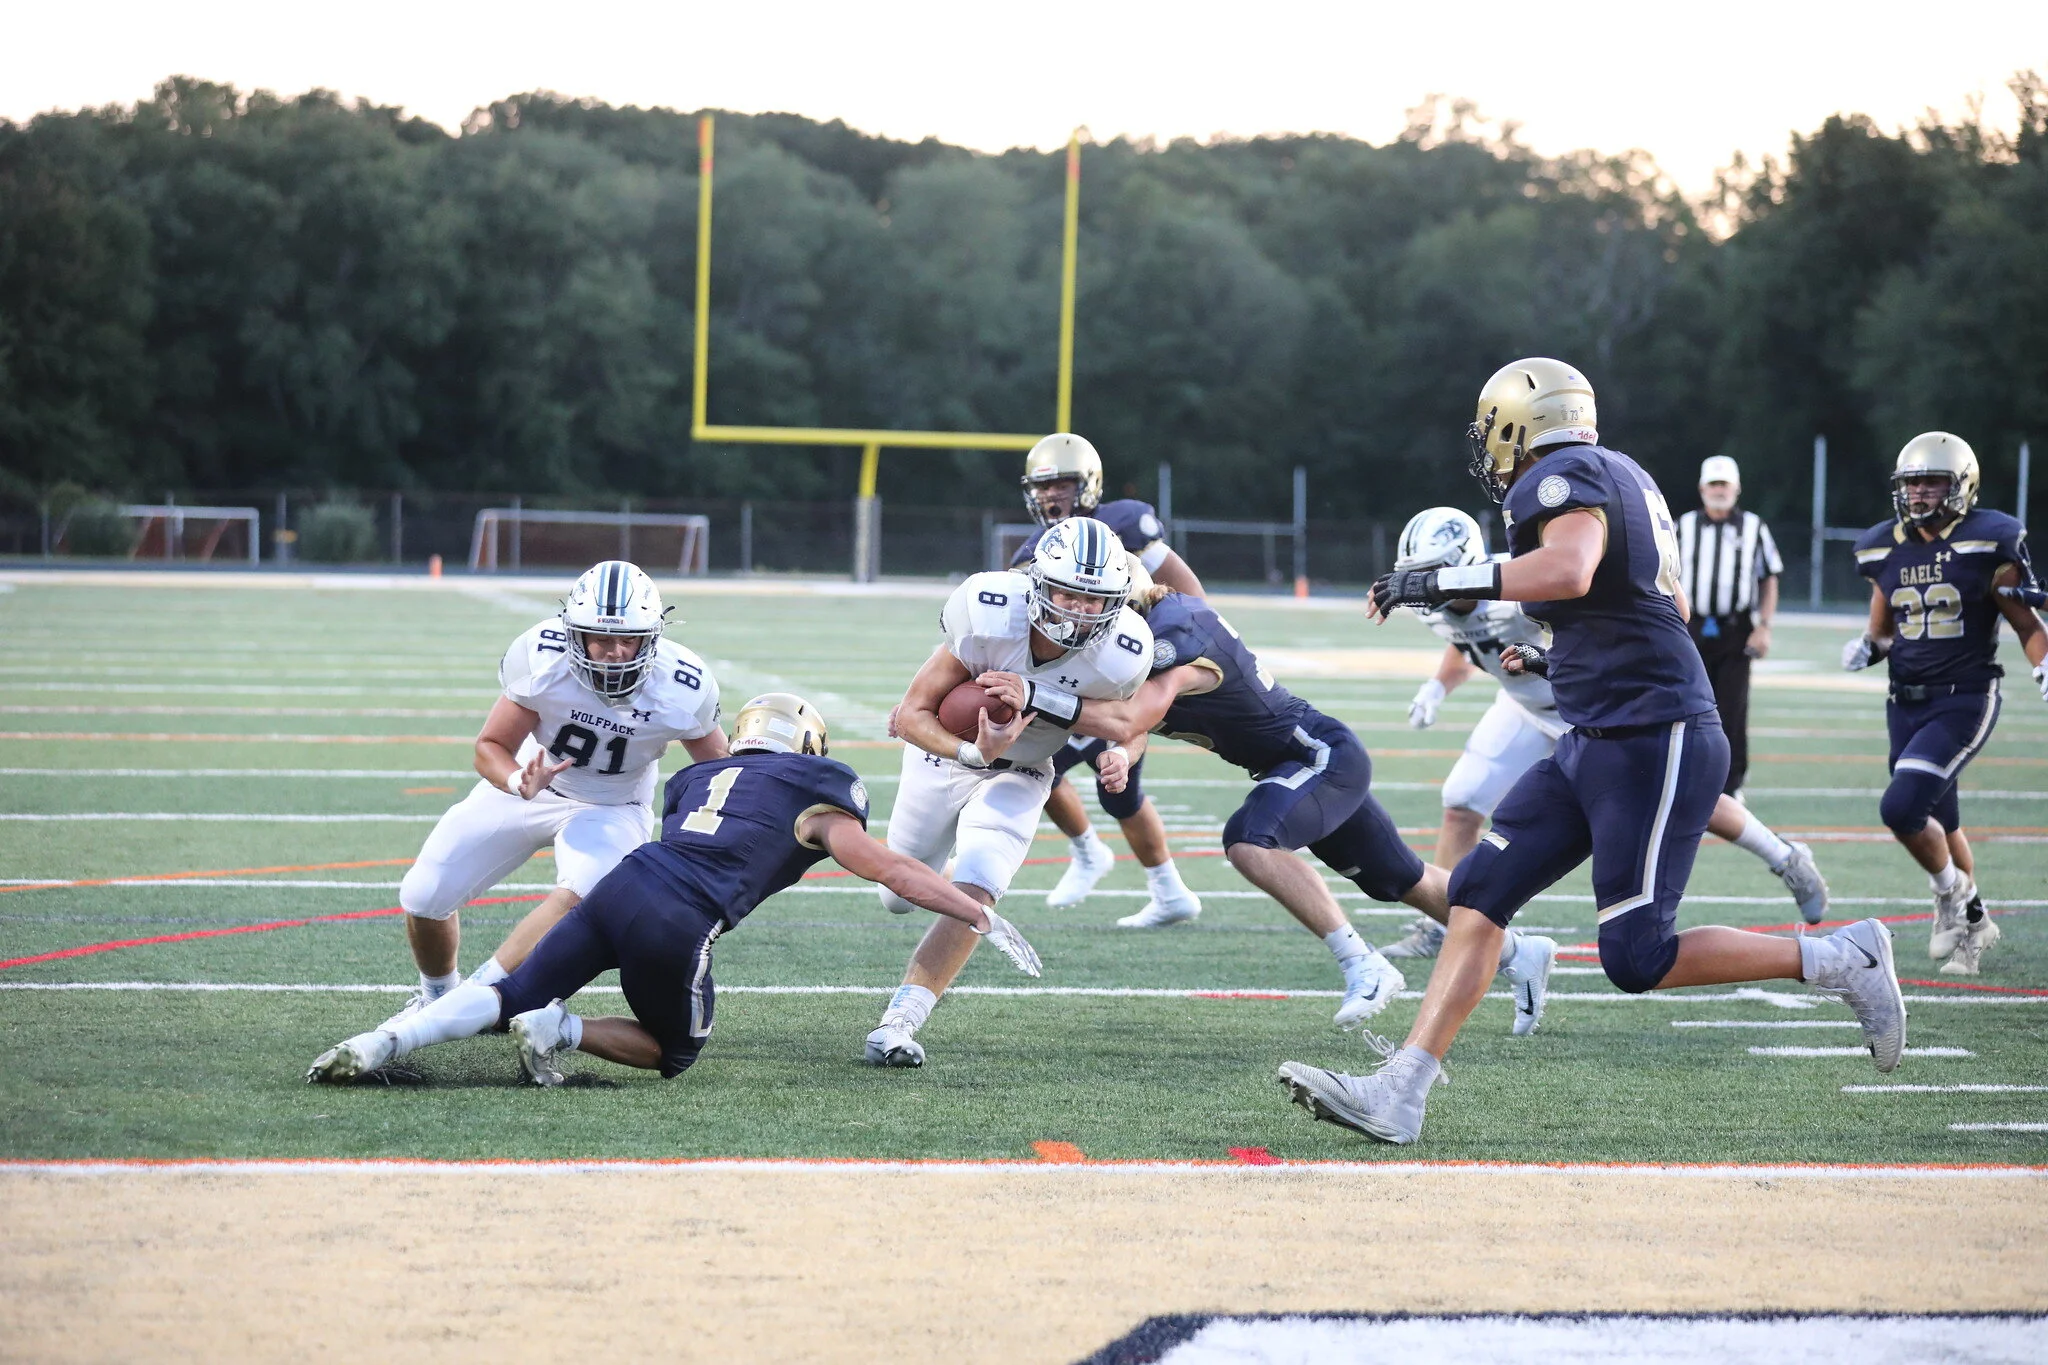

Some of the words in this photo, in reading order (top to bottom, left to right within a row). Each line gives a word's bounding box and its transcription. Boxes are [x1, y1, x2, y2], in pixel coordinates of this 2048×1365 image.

[1900, 563, 1943, 586] GAELS
[978, 591, 1008, 607] 8
[1890, 583, 1964, 640] 32
[538, 629, 568, 654] 81
[1116, 633, 1143, 656] 8
[673, 659, 703, 691] 81
[570, 709, 636, 736] WOLFPACK
[680, 767, 744, 836] 1
